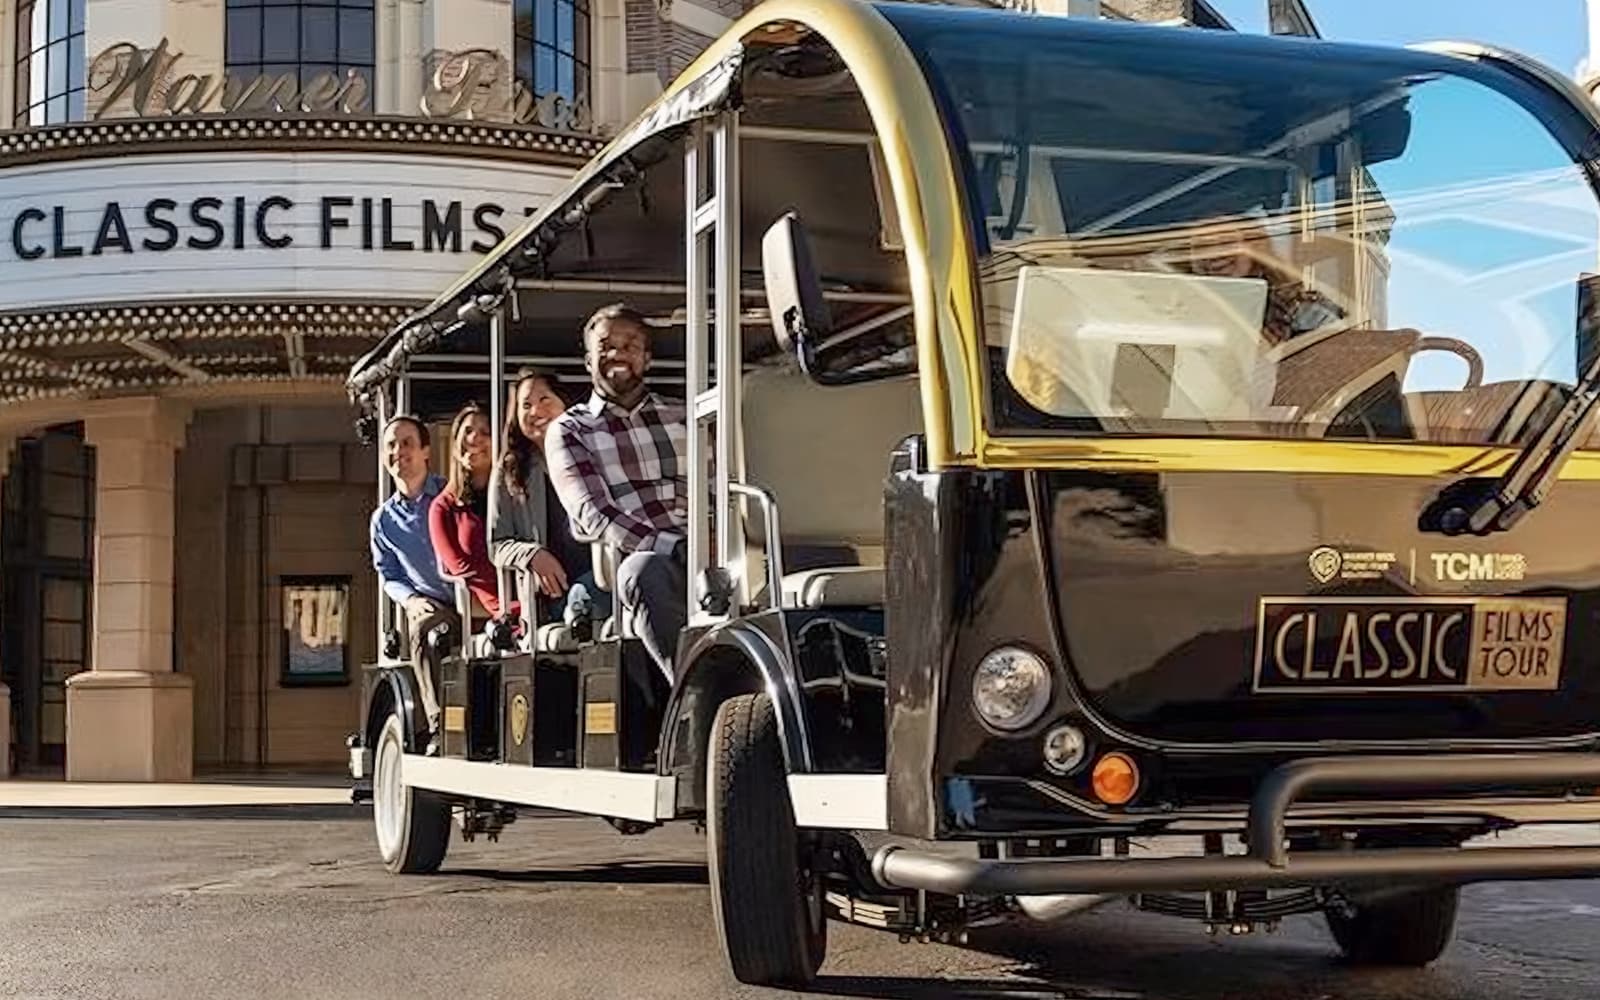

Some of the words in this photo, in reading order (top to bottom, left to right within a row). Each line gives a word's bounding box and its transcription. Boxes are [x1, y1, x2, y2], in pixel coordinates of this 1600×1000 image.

[88, 36, 368, 119] Warner
[12, 196, 293, 260] CLASSIC
[320, 197, 506, 254] FILMS
[1430, 552, 1494, 581] TCM
[1275, 612, 1464, 680] CLASSIC
[1484, 611, 1553, 643] FILMS
[1480, 646, 1550, 678] TOUR
